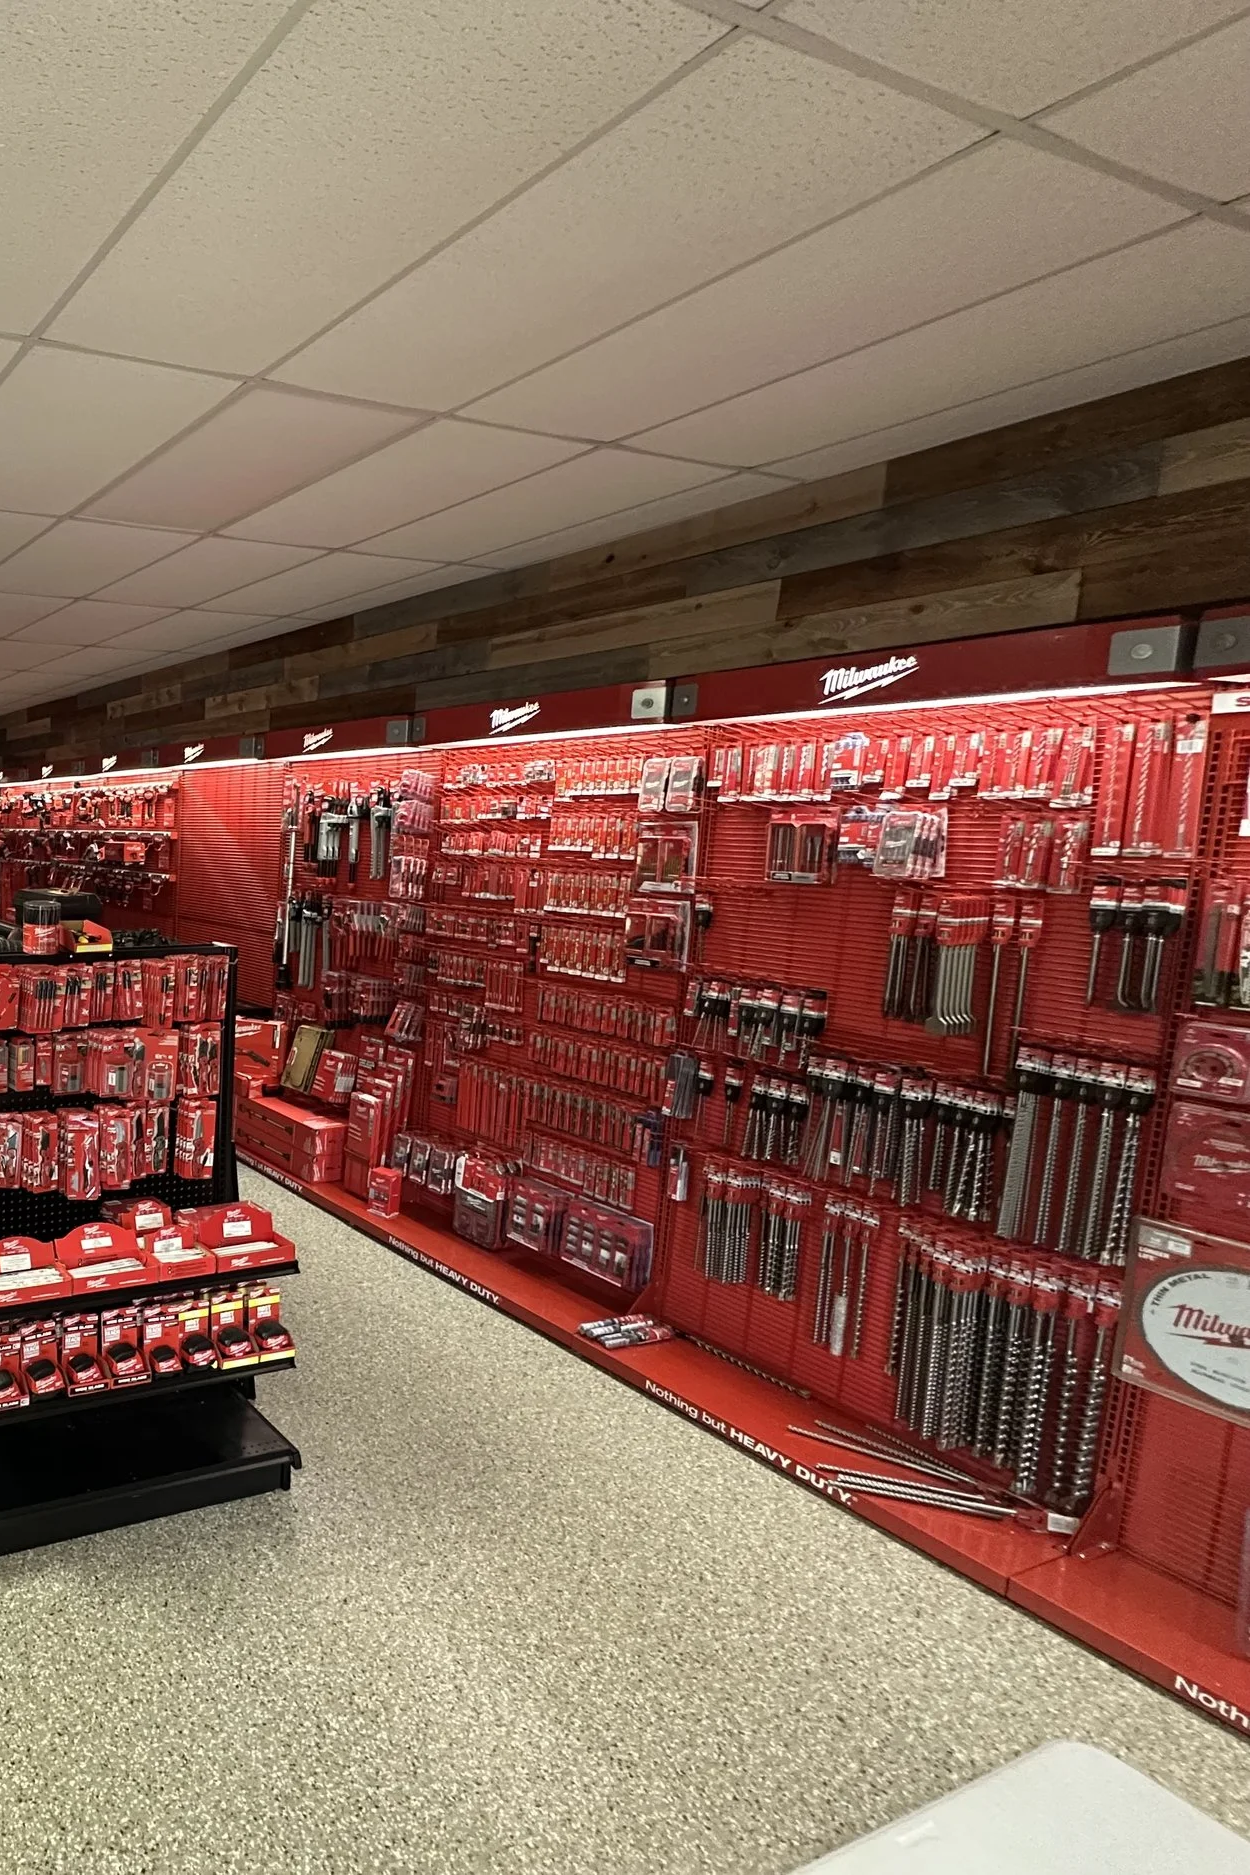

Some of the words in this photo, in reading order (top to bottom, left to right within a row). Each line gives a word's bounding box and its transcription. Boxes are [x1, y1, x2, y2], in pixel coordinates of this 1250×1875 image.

[819, 655, 918, 700] Milwaukee
[490, 702, 541, 732] Milwaukee
[302, 728, 334, 751] Milwaukee
[264, 1165, 285, 1181] HEAVY
[388, 1235, 419, 1260] Nothing
[420, 1253, 434, 1268] but
[435, 1262, 468, 1287] HEAVY
[1151, 1286, 1170, 1306] THIN
[1170, 1273, 1211, 1288] METAL
[645, 1380, 698, 1418] Nothing
[702, 1411, 726, 1433] but
[730, 1428, 792, 1469] HEAVY
